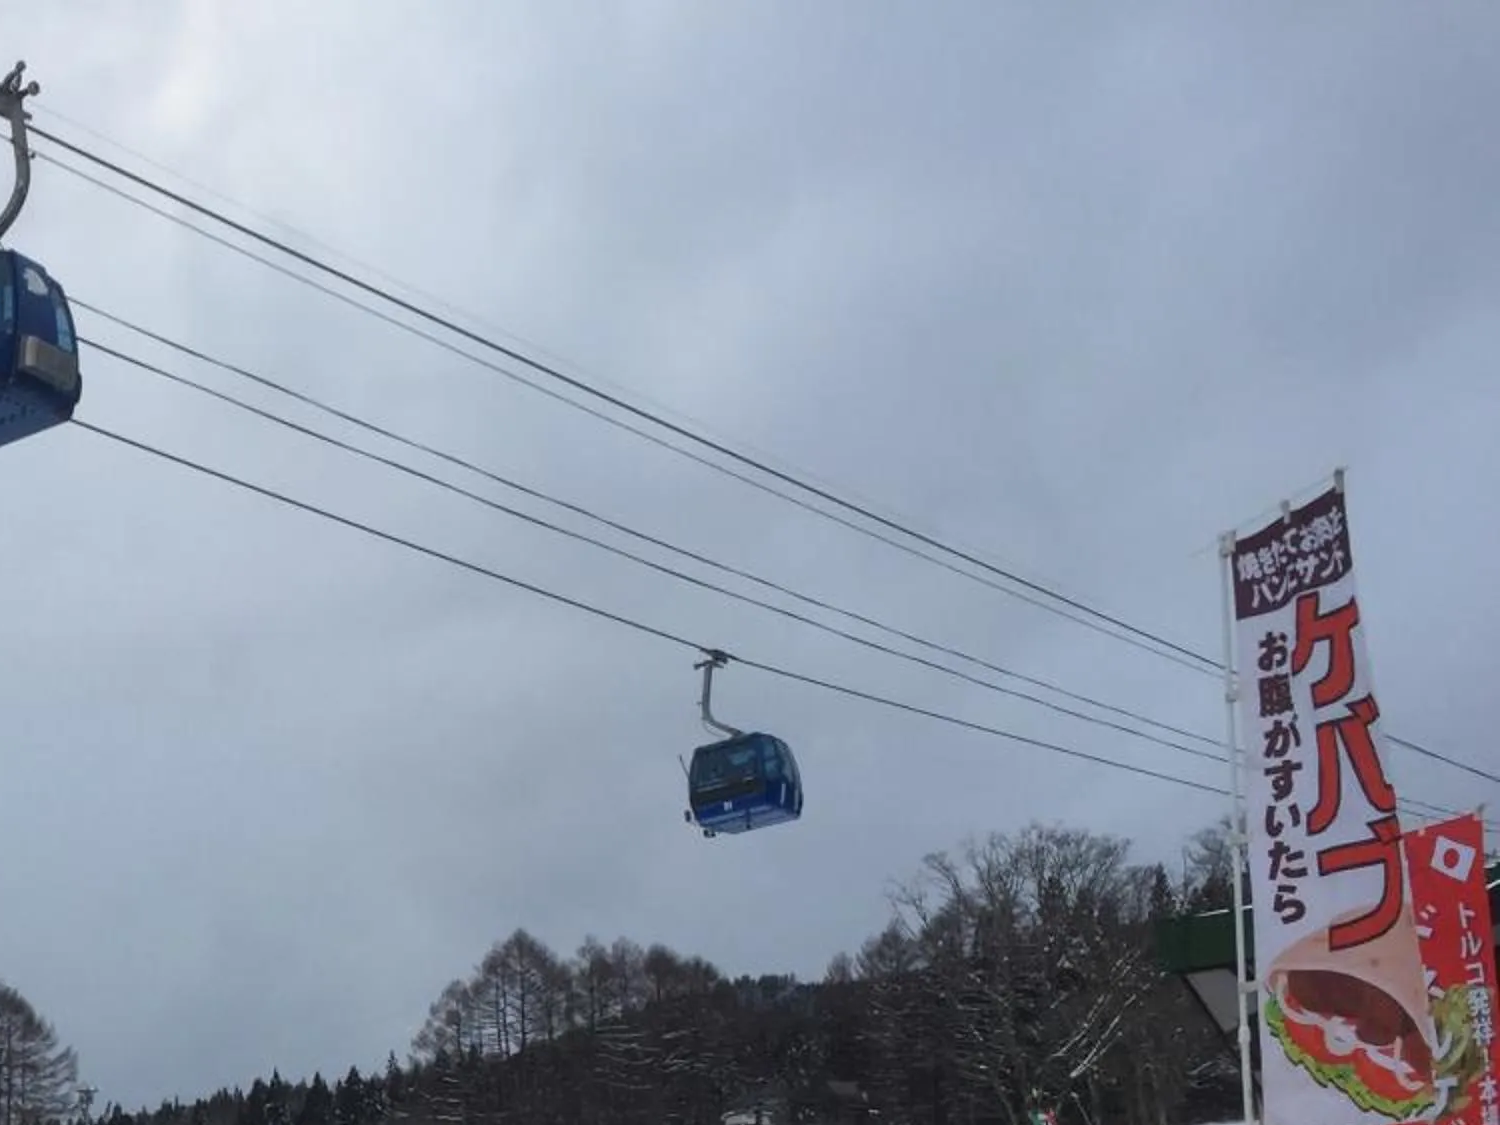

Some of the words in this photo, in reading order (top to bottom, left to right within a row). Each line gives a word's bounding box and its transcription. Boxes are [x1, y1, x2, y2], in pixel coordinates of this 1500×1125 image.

[1257, 632, 1308, 925] お腹がすいたら
[1291, 590, 1403, 951] ケバブ
